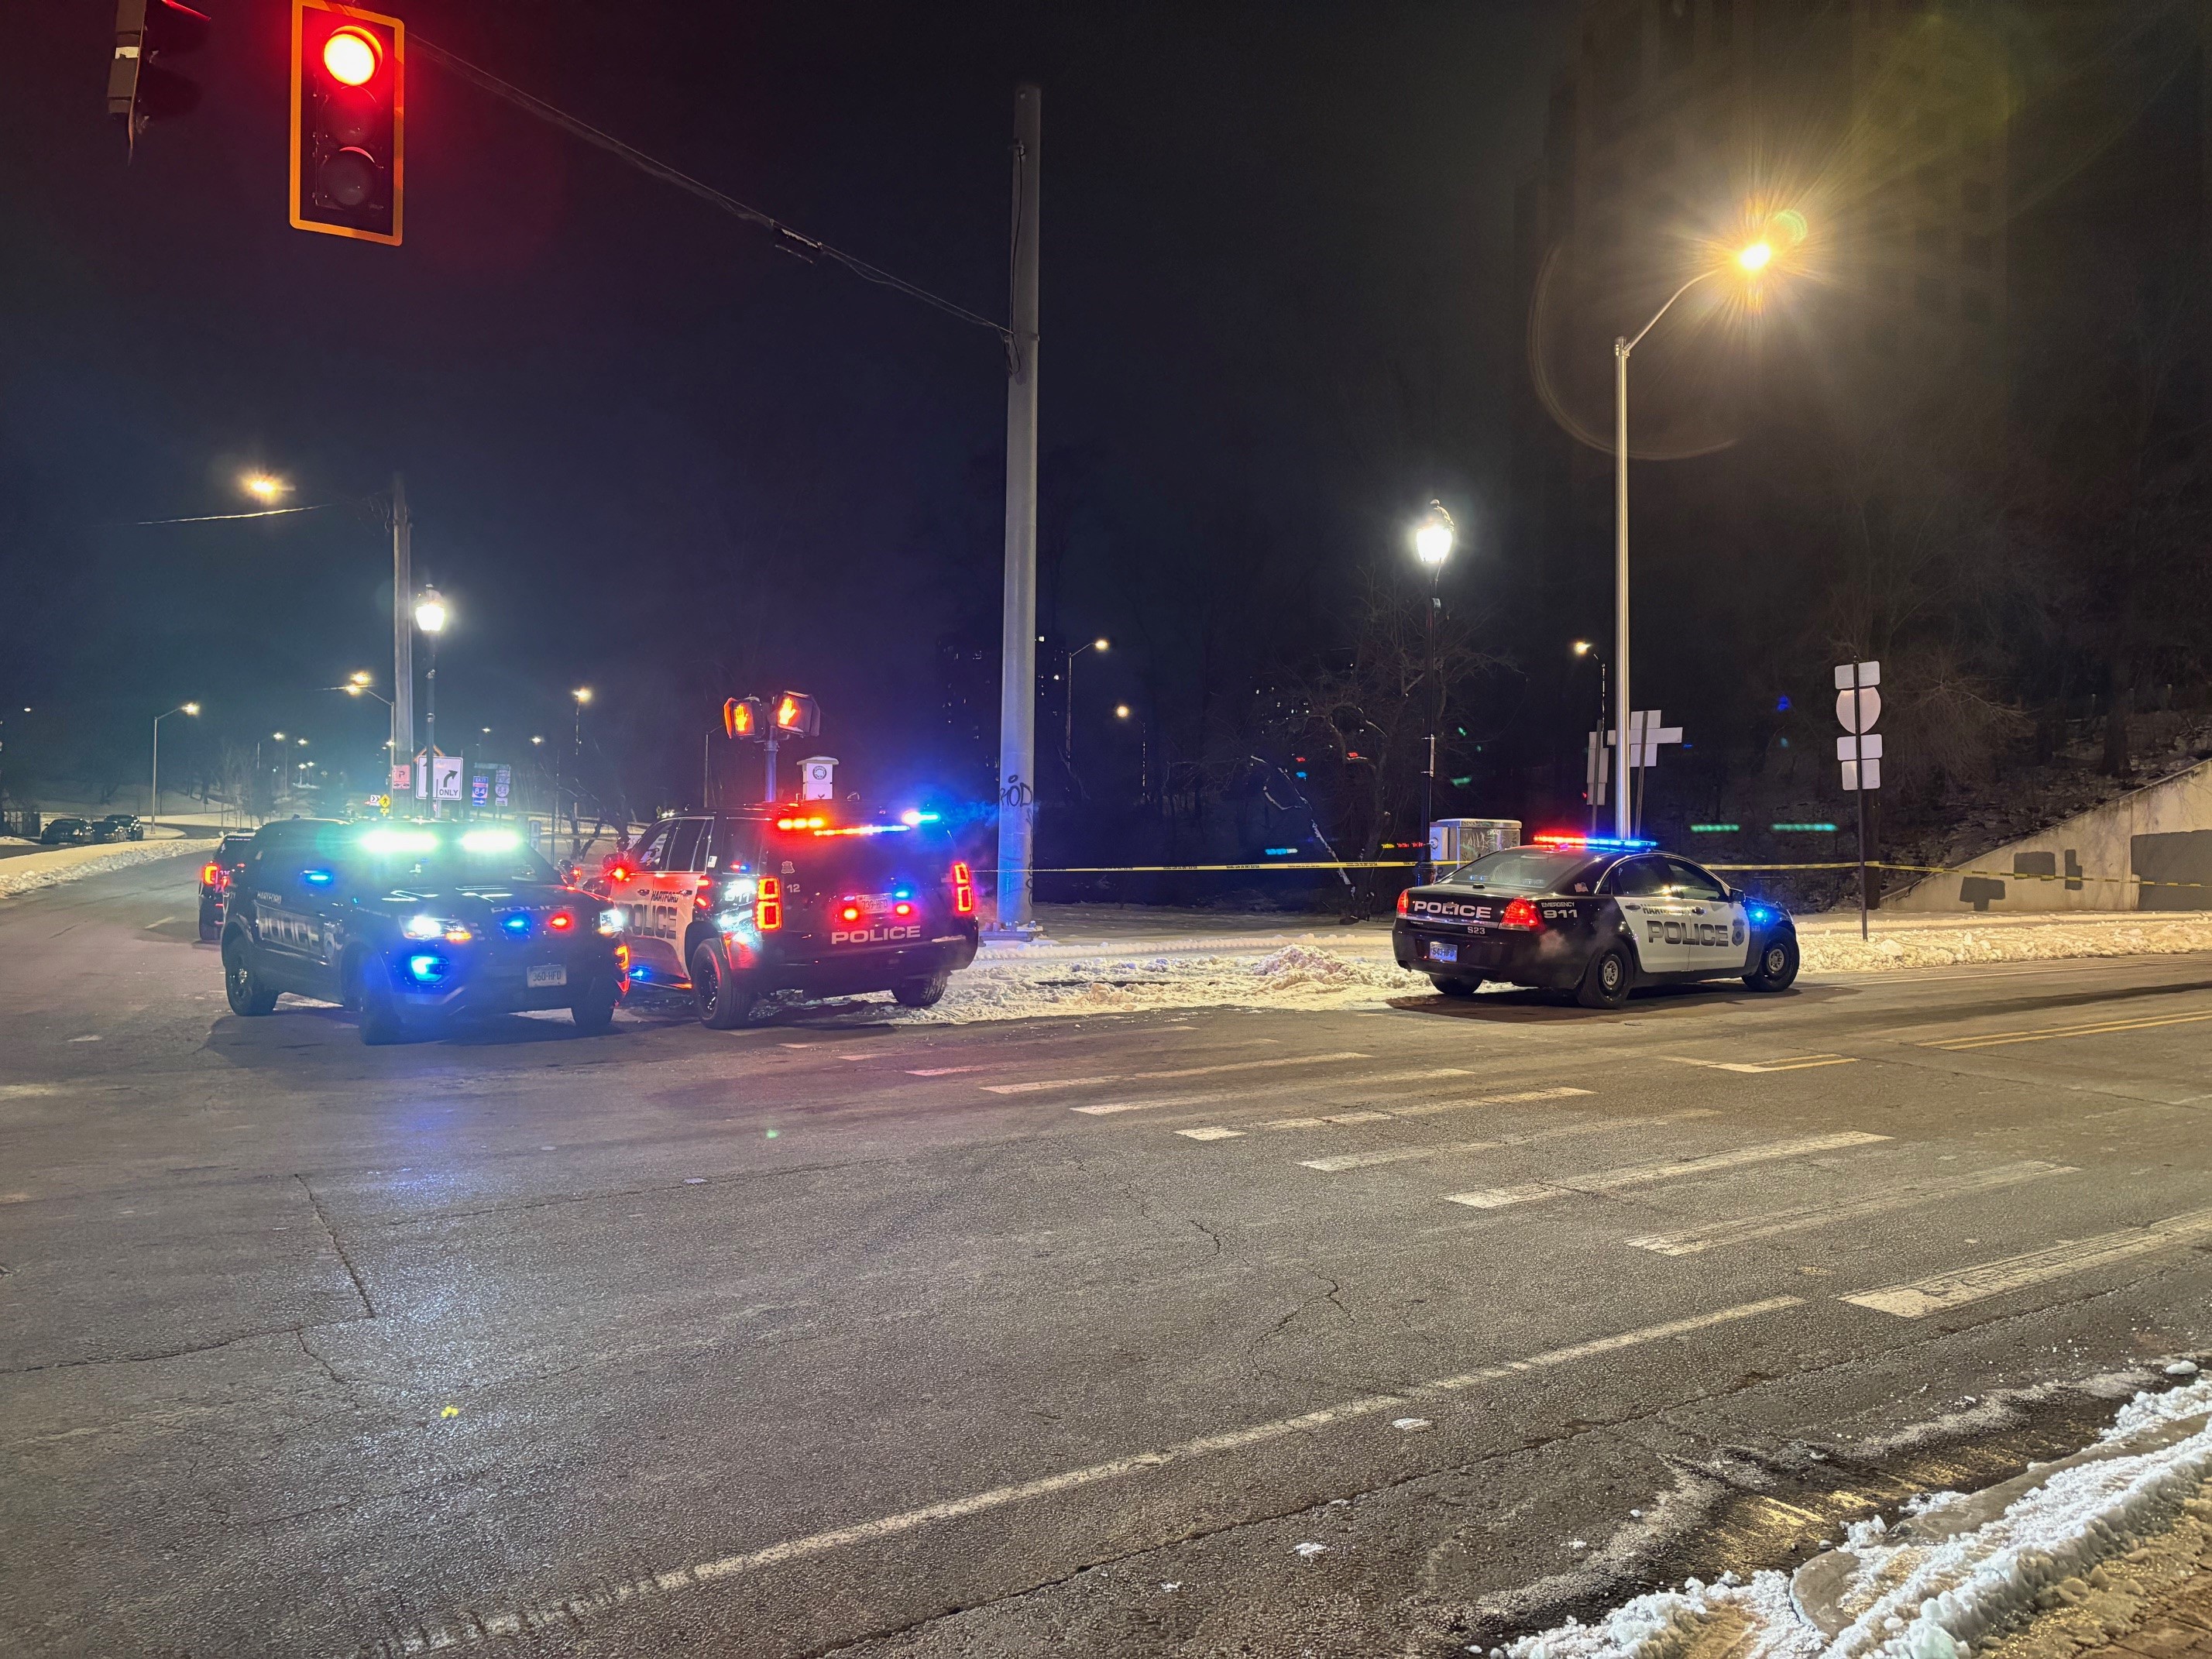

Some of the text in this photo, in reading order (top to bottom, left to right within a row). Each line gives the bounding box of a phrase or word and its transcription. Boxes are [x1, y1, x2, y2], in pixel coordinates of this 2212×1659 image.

[786, 884, 801, 893] 12
[490, 905, 575, 913] POLICE
[1413, 900, 1492, 919] POLICE
[1543, 909, 1578, 919] 911
[831, 926, 921, 945] POLICE
[1467, 926, 1486, 935] S23
[1647, 920, 1729, 946] POLICE
